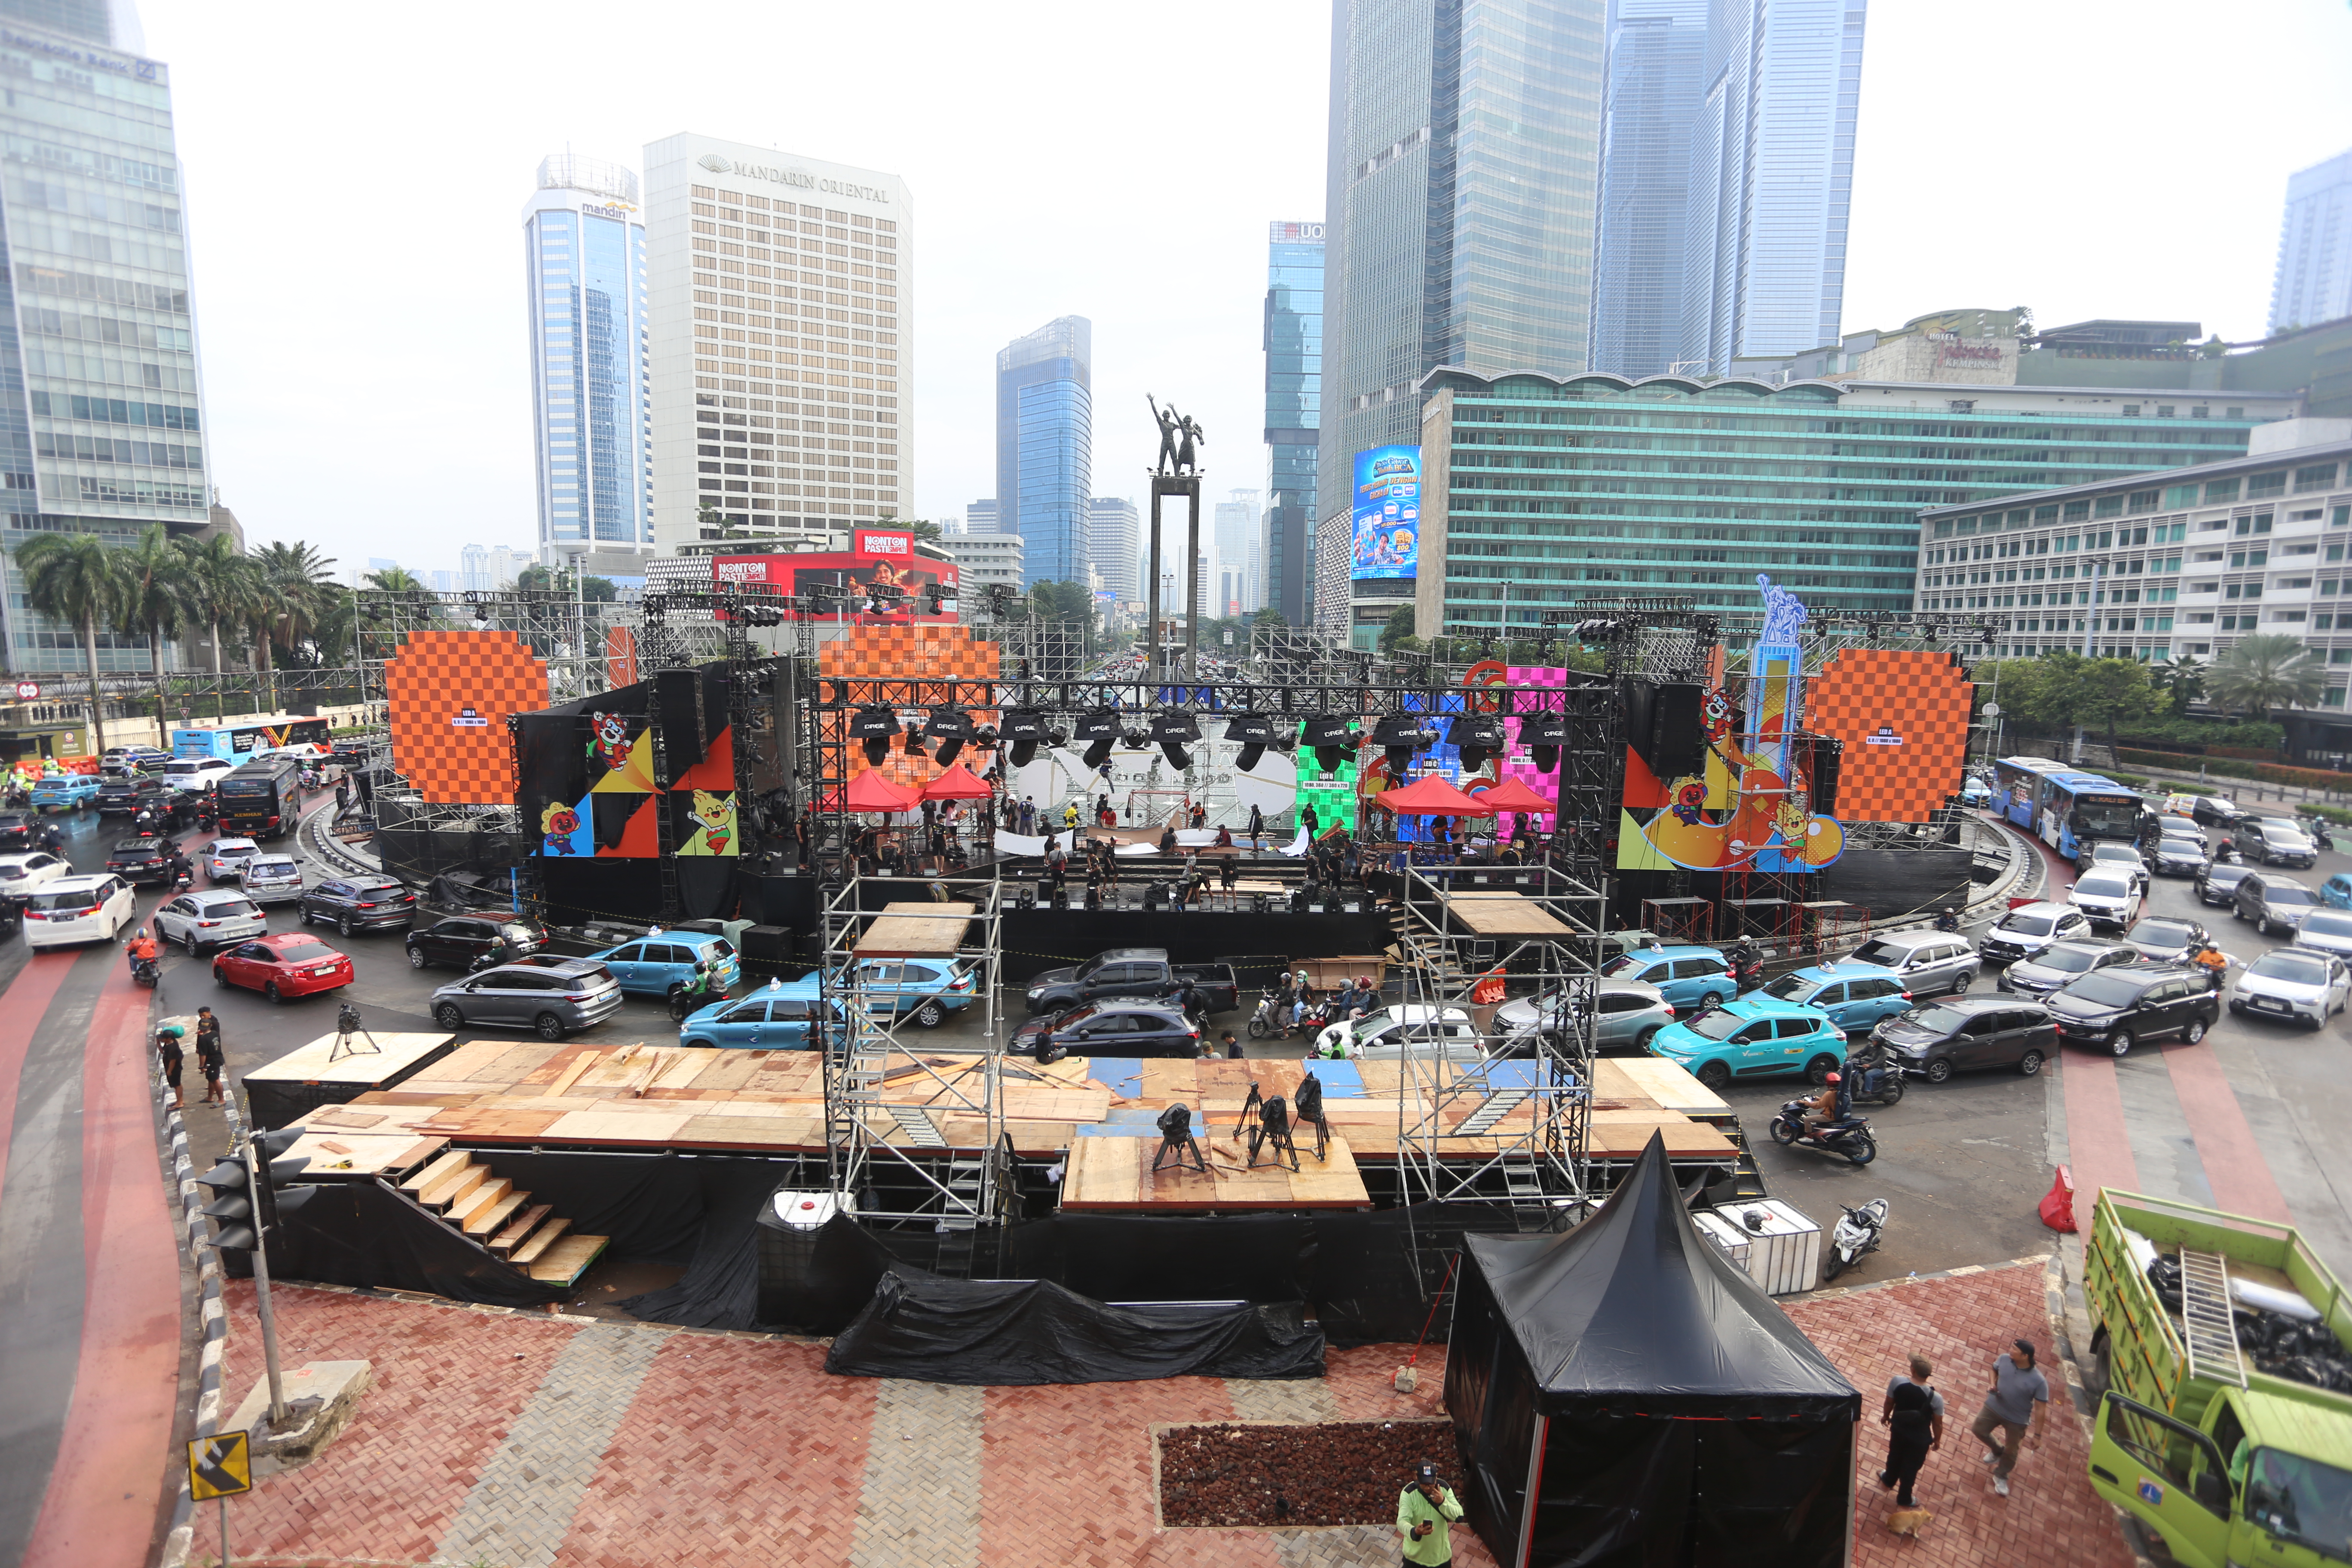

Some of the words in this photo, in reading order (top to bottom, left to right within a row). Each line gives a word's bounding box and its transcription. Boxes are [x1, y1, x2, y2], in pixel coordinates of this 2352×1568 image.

[1, 29, 81, 61] Deutsche
[87, 52, 128, 73] Bank
[734, 161, 815, 189] MANDARIN
[820, 178, 889, 203] ORIENTAL
[582, 203, 625, 220] mandiri
[1301, 225, 1326, 239] UO
[1945, 358, 2001, 369] KEMPINSKI
[1360, 483, 1372, 494] TERUS
[1389, 476, 1418, 484] DENGAN
[865, 536, 907, 546] NONTON
[865, 545, 888, 553] PASTI
[719, 562, 766, 573] NONTON
[719, 573, 744, 581] PASTI
